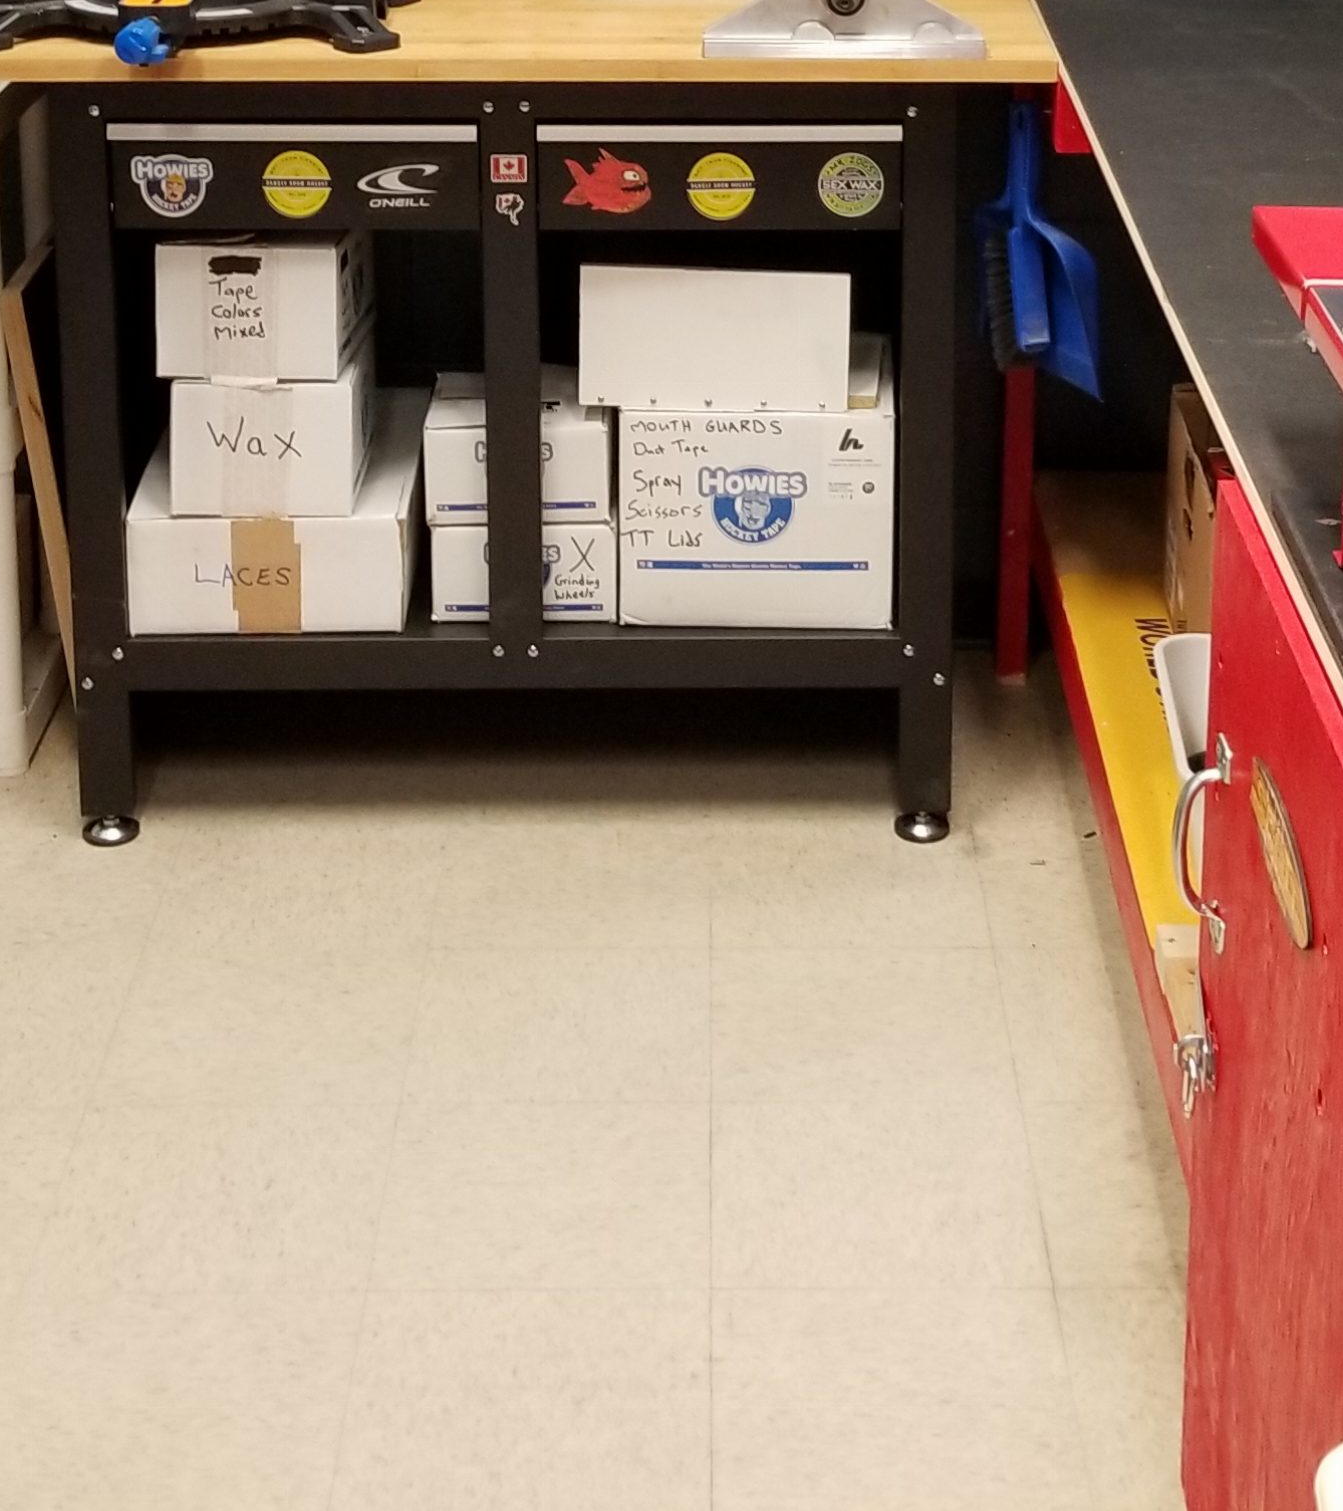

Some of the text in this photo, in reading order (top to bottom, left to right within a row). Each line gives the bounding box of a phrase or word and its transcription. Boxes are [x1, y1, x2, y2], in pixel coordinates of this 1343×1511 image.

[136, 160, 209, 180] HOWIES
[823, 179, 878, 191] SEX WAX
[369, 197, 430, 208] O'NEILL
[208, 276, 258, 304] Tape
[207, 416, 302, 459] Wax
[630, 419, 783, 435] MOUTH GUARDS
[671, 439, 709, 457] Tape
[633, 469, 682, 497] Spray
[699, 467, 808, 498] HOWIES
[625, 499, 703, 521] Scissors
[720, 517, 787, 542] HOCKEY TAPE
[194, 562, 292, 589] LACES
[555, 573, 600, 588] Grinding
